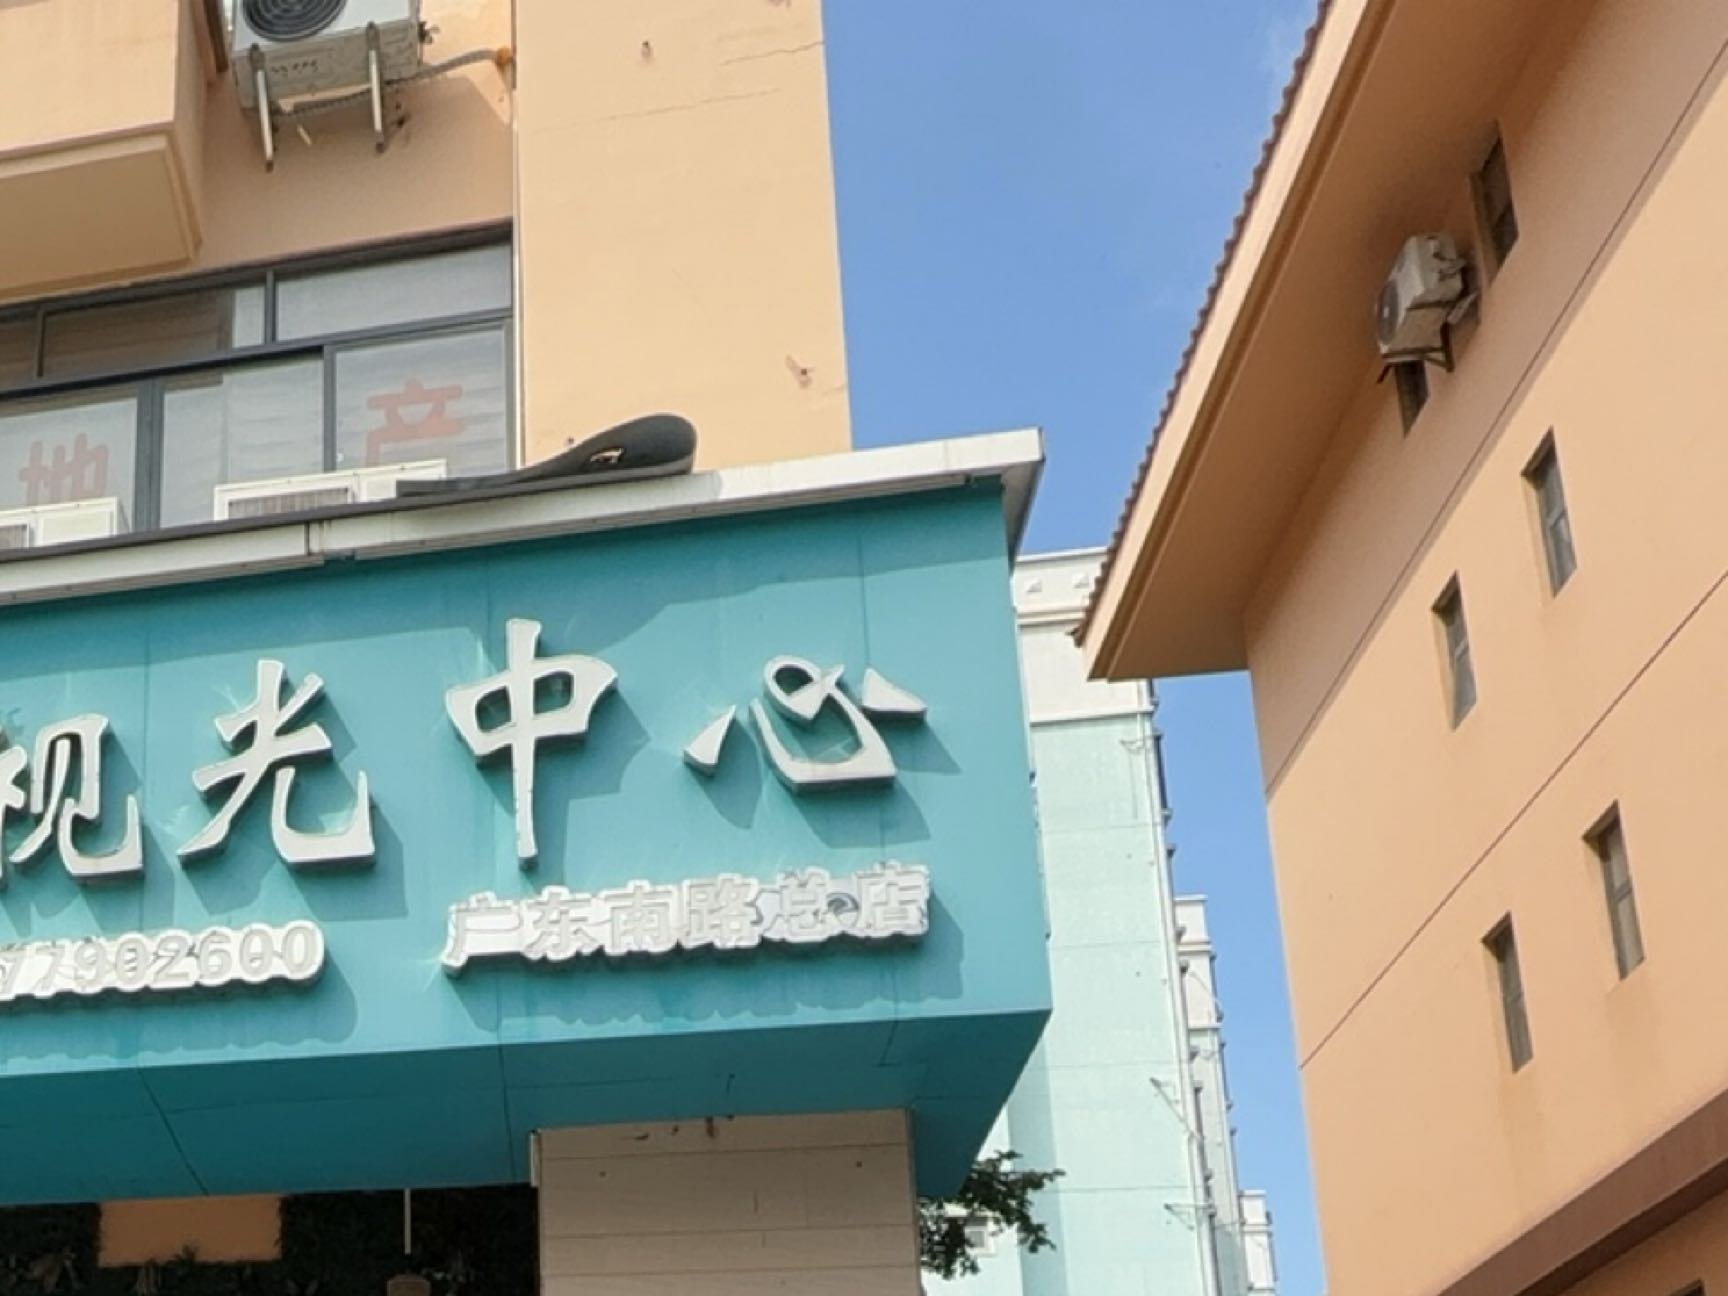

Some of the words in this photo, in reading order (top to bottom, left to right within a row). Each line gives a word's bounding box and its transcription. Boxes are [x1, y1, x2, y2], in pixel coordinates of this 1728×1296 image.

[441, 860, 931, 968] 广东南路总店
